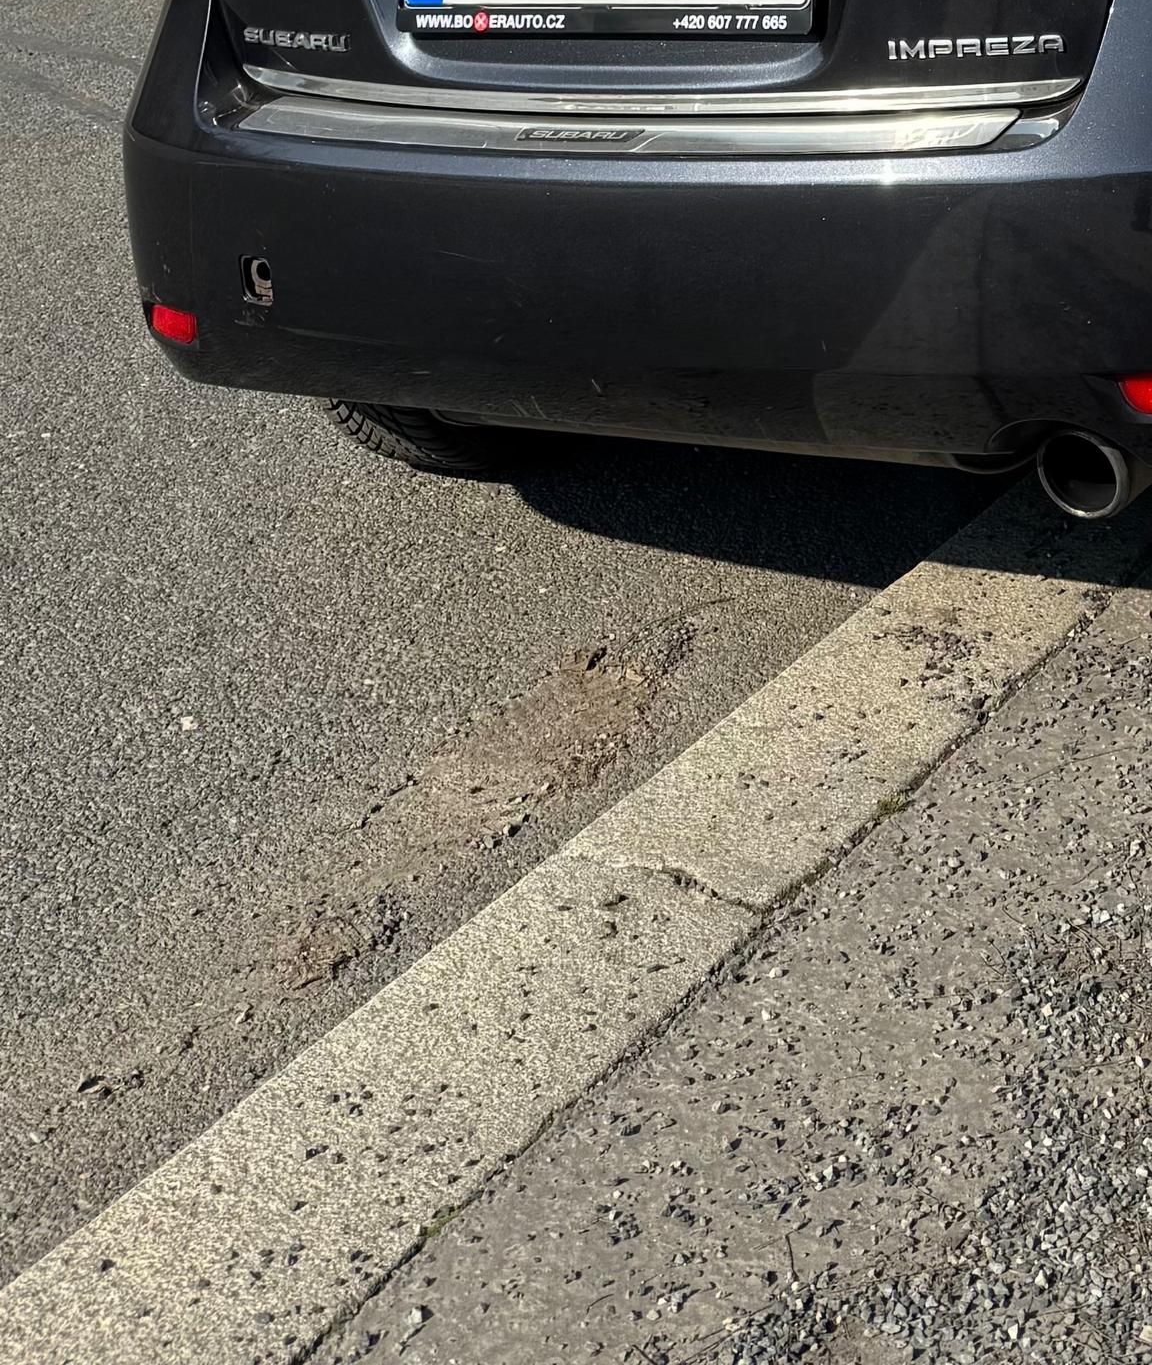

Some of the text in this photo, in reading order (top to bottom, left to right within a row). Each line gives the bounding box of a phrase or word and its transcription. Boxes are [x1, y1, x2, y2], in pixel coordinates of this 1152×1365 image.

[415, 13, 566, 31] WWW.BOXERAUTO.CZ
[672, 14, 788, 30] +420 607 777 665
[243, 27, 350, 53] SUBARU
[887, 34, 1065, 60] IMPREZA
[529, 129, 628, 140] SUBARU
